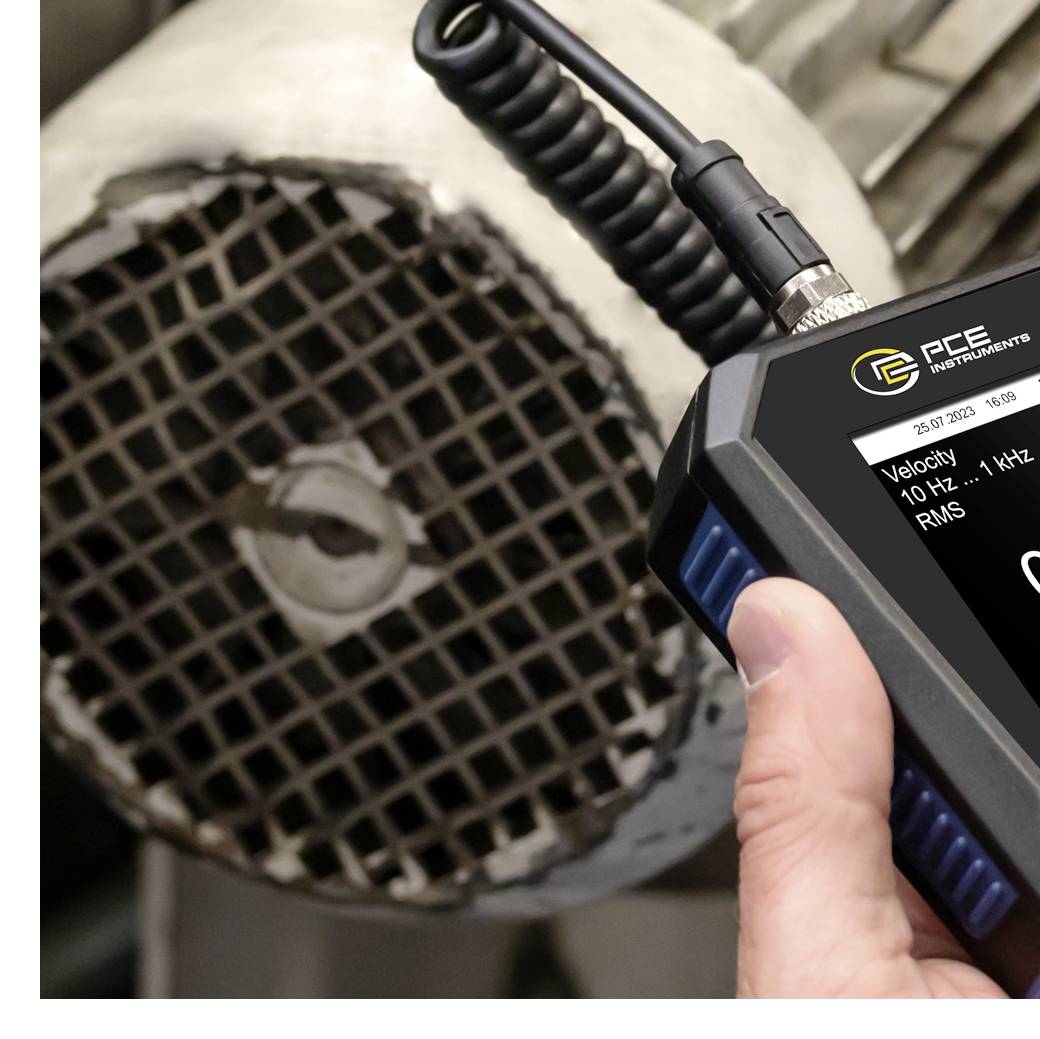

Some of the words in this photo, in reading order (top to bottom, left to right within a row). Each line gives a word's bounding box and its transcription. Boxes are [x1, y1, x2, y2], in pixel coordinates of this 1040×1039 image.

[920, 325, 991, 364] PCE
[930, 333, 1031, 374] INSTRUMENTS
[914, 406, 976, 435] 25.07.2023
[985, 391, 1017, 410] 16:09
[881, 447, 957, 484] Velocity
[901, 484, 927, 506] 10
[928, 474, 958, 498] Hz
[979, 460, 994, 477] 1
[993, 446, 1035, 473] kHz
[915, 501, 966, 531] RMS
